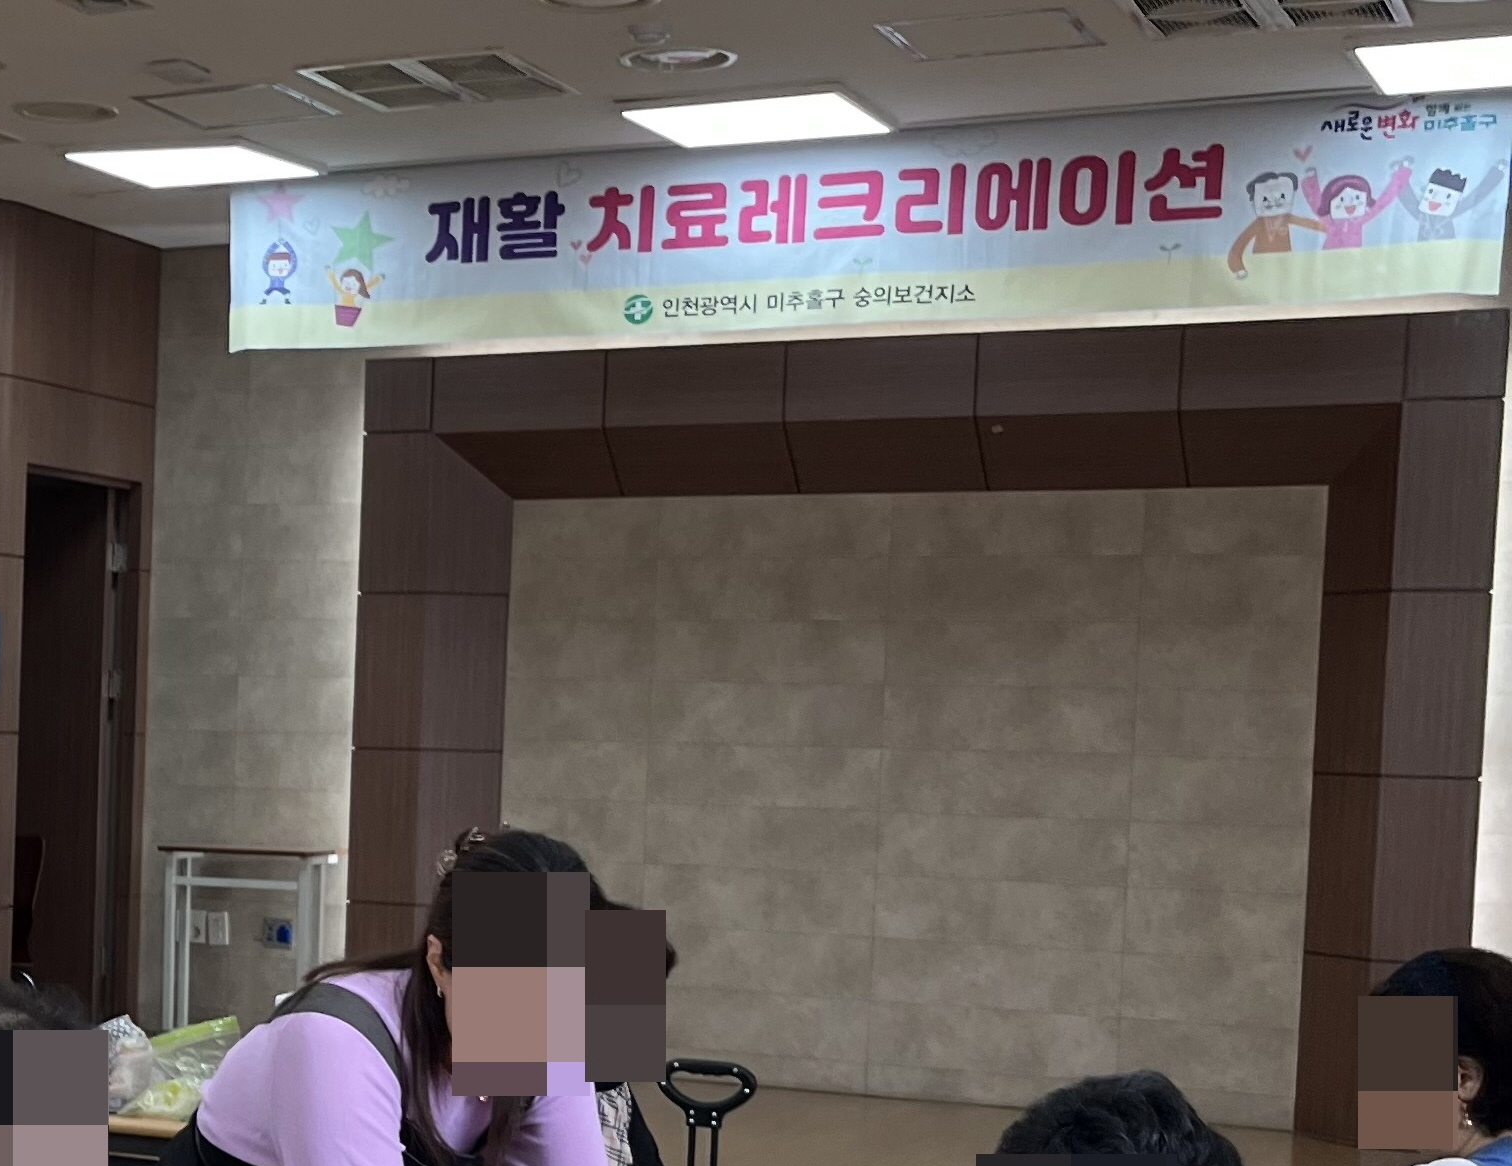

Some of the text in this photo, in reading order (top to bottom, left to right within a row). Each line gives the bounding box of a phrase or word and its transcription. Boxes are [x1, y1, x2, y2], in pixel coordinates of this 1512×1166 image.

[1320, 108, 1497, 141] 새로운 변화 미추홀구
[425, 143, 1225, 264] 재활 치료레크리에이션
[662, 283, 977, 318] 인천광역시 미추홀구 숭의보건지소
